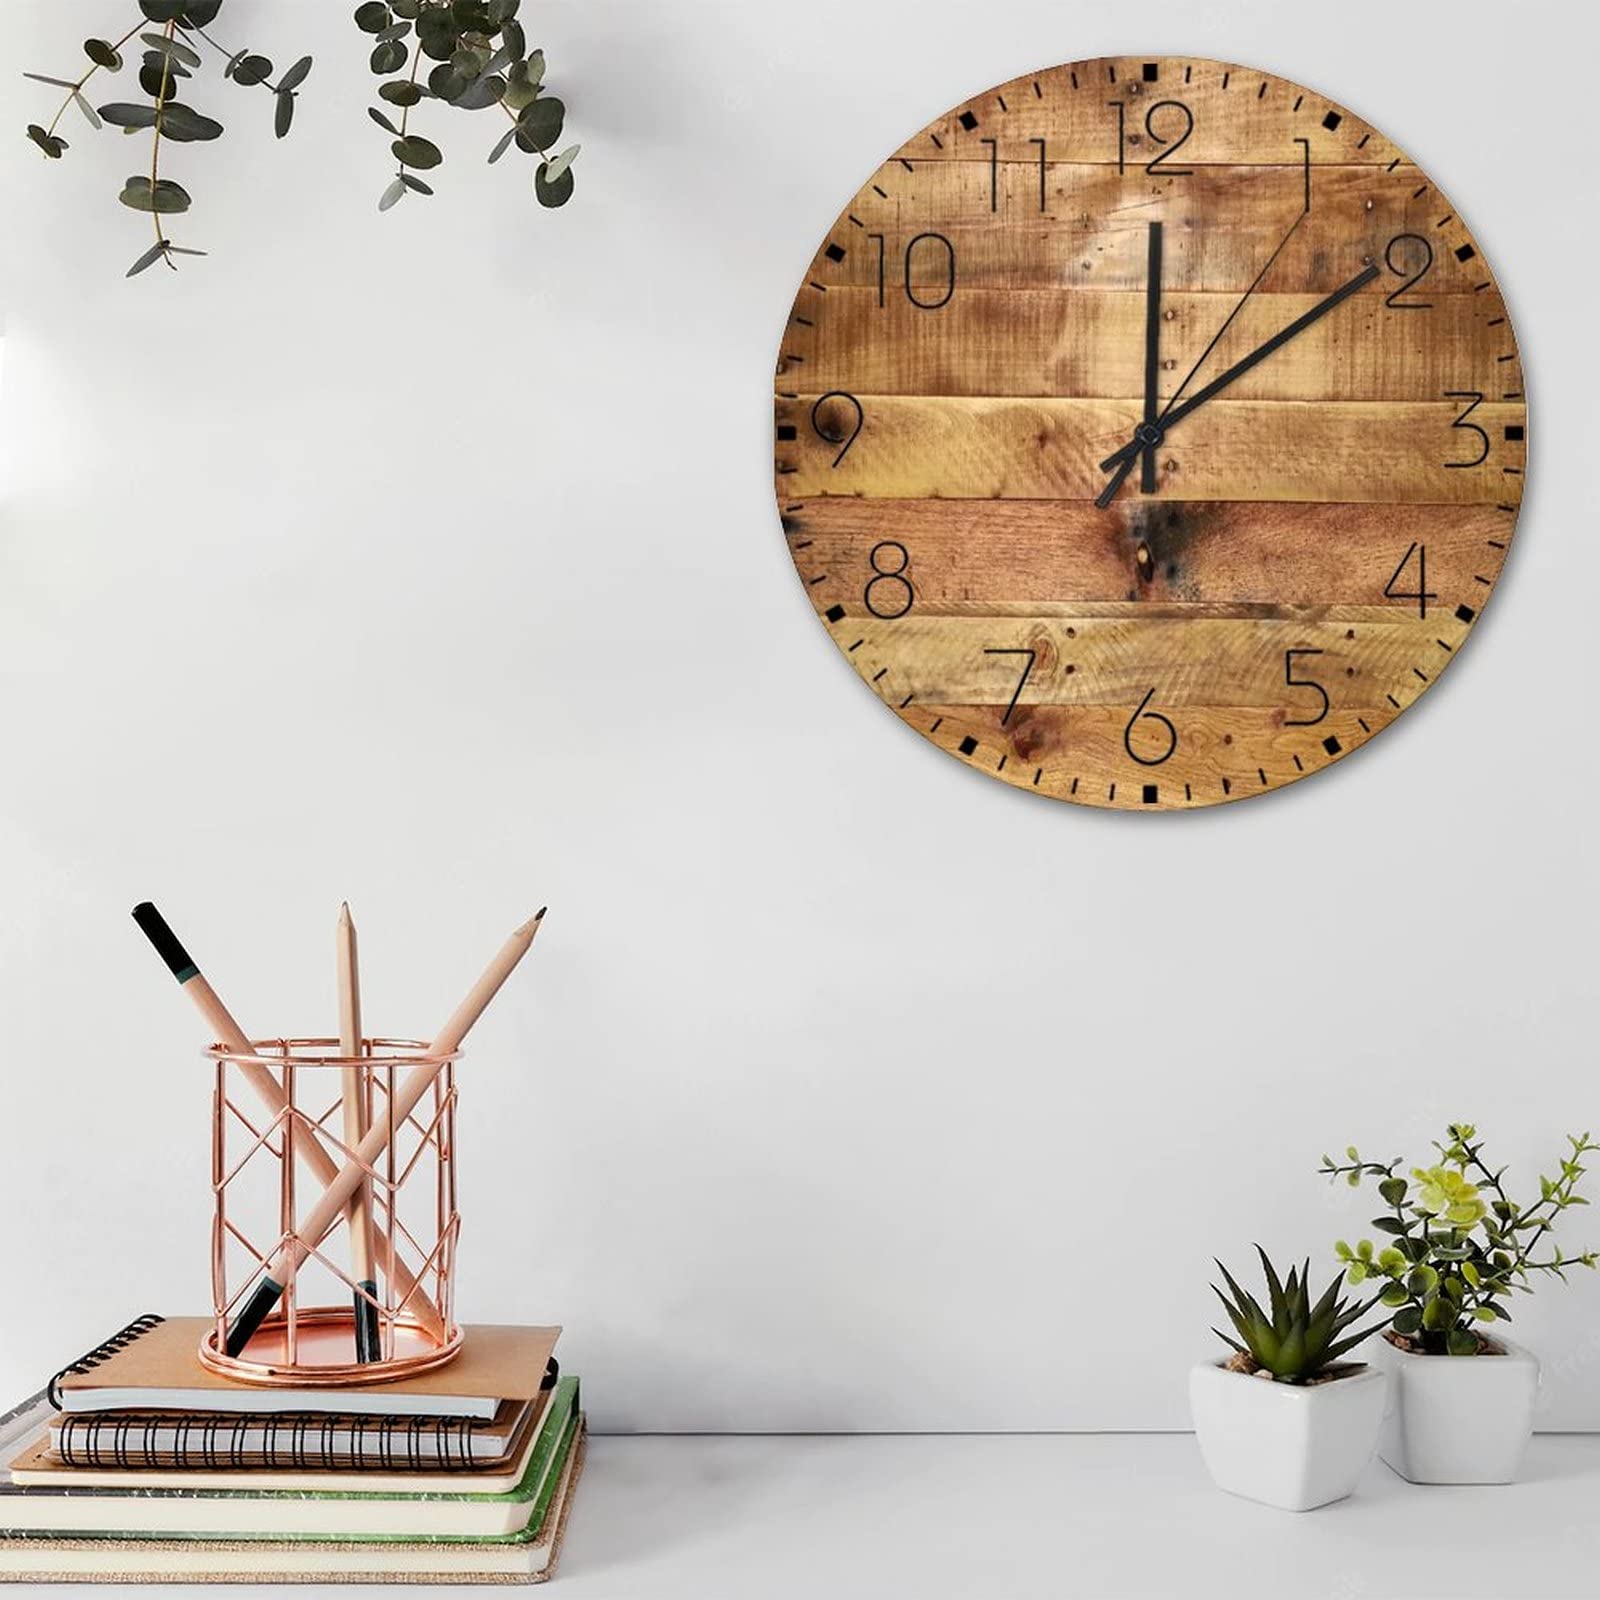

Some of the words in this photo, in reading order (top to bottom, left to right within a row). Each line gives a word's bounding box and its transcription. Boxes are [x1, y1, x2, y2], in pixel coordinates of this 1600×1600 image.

[980, 138, 1047, 214] 11
[1107, 100, 1195, 176] 12
[1291, 138, 1311, 214] 1
[867, 232, 956, 309] 10
[1383, 232, 1434, 309] 2
[810, 390, 864, 468] 9
[1443, 391, 1491, 468] 3
[863, 541, 915, 620] 8
[1383, 541, 1438, 620] 4
[983, 649, 1037, 726] 7
[1283, 649, 1330, 726] 5
[1124, 687, 1178, 767] 6
